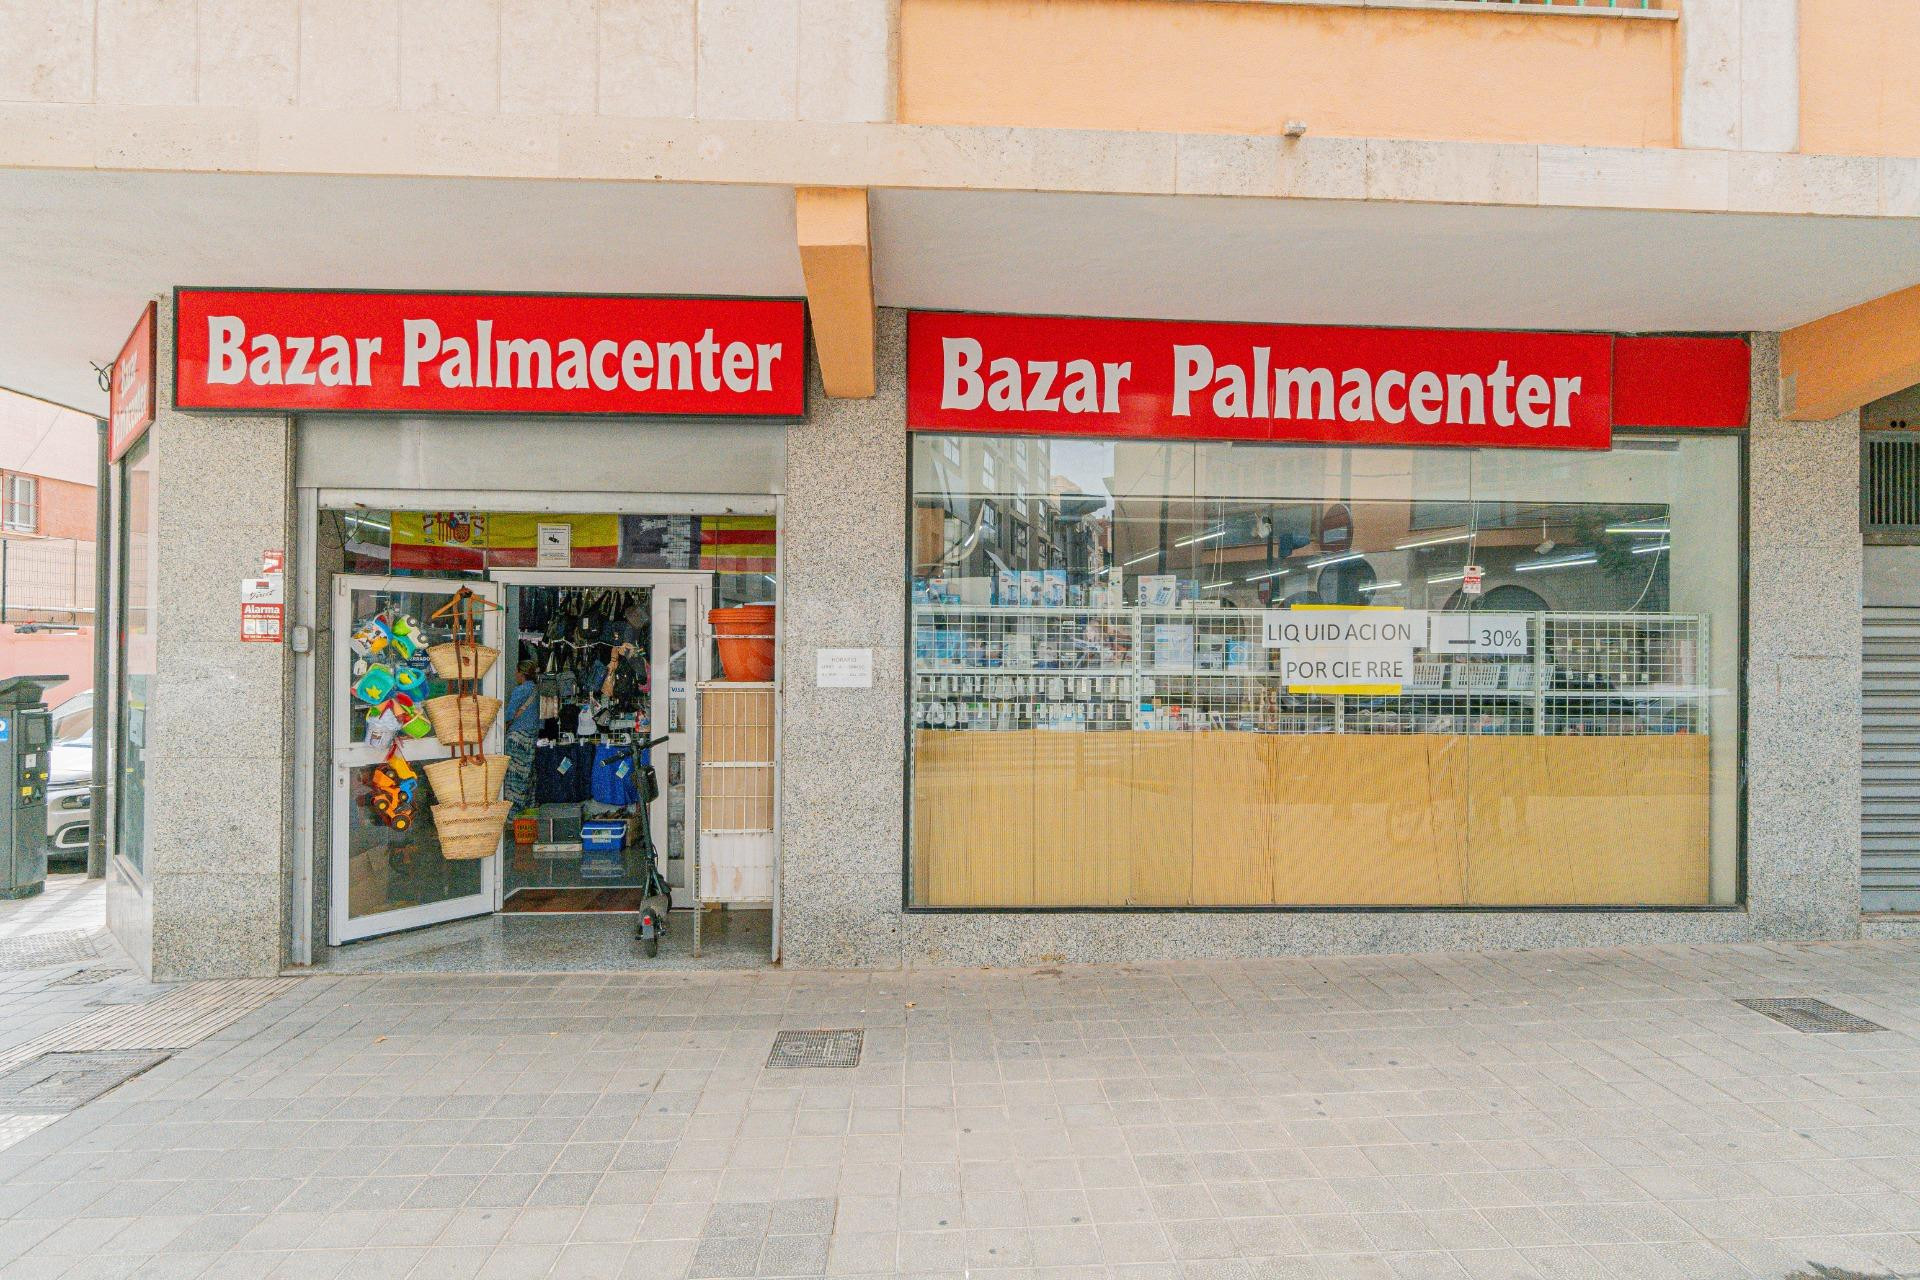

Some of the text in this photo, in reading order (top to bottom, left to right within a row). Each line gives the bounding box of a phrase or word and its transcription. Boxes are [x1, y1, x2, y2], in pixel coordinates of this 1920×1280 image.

[207, 315, 382, 386] Bazar
[402, 318, 783, 392] Palmacenter
[941, 337, 1583, 428] Bazar Palmacenter
[244, 604, 280, 614] Alarma
[1268, 623, 1411, 642] LIQUIDACION
